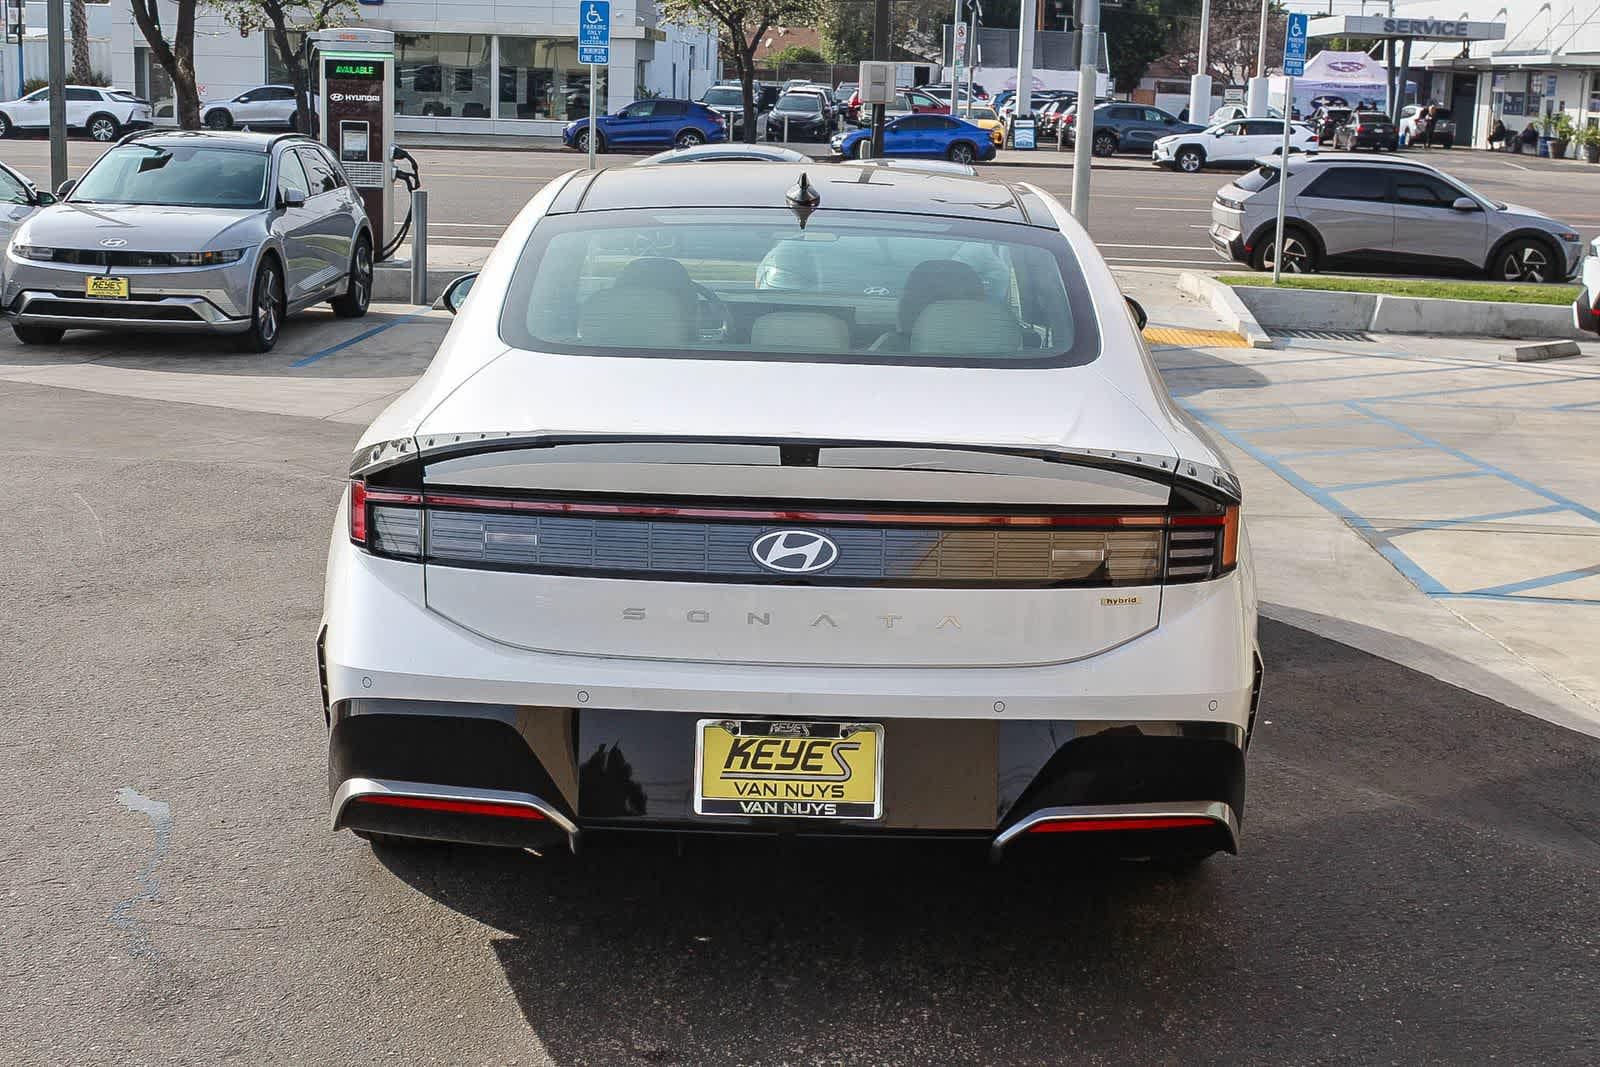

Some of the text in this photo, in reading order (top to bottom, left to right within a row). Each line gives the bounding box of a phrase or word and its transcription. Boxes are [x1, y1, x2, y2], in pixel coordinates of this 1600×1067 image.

[1384, 20, 1468, 36] SERVICE
[335, 65, 375, 75] AVAILABLE
[345, 94, 380, 102] HYUNDAI
[91, 280, 124, 289] KEYES
[1106, 597, 1137, 605] hybrid
[622, 607, 962, 630] SONATA
[770, 722, 812, 737] KEYES
[721, 738, 861, 780] KEYES
[733, 781, 845, 798] VAN NUYS
[739, 801, 837, 815] VAN NUYS
